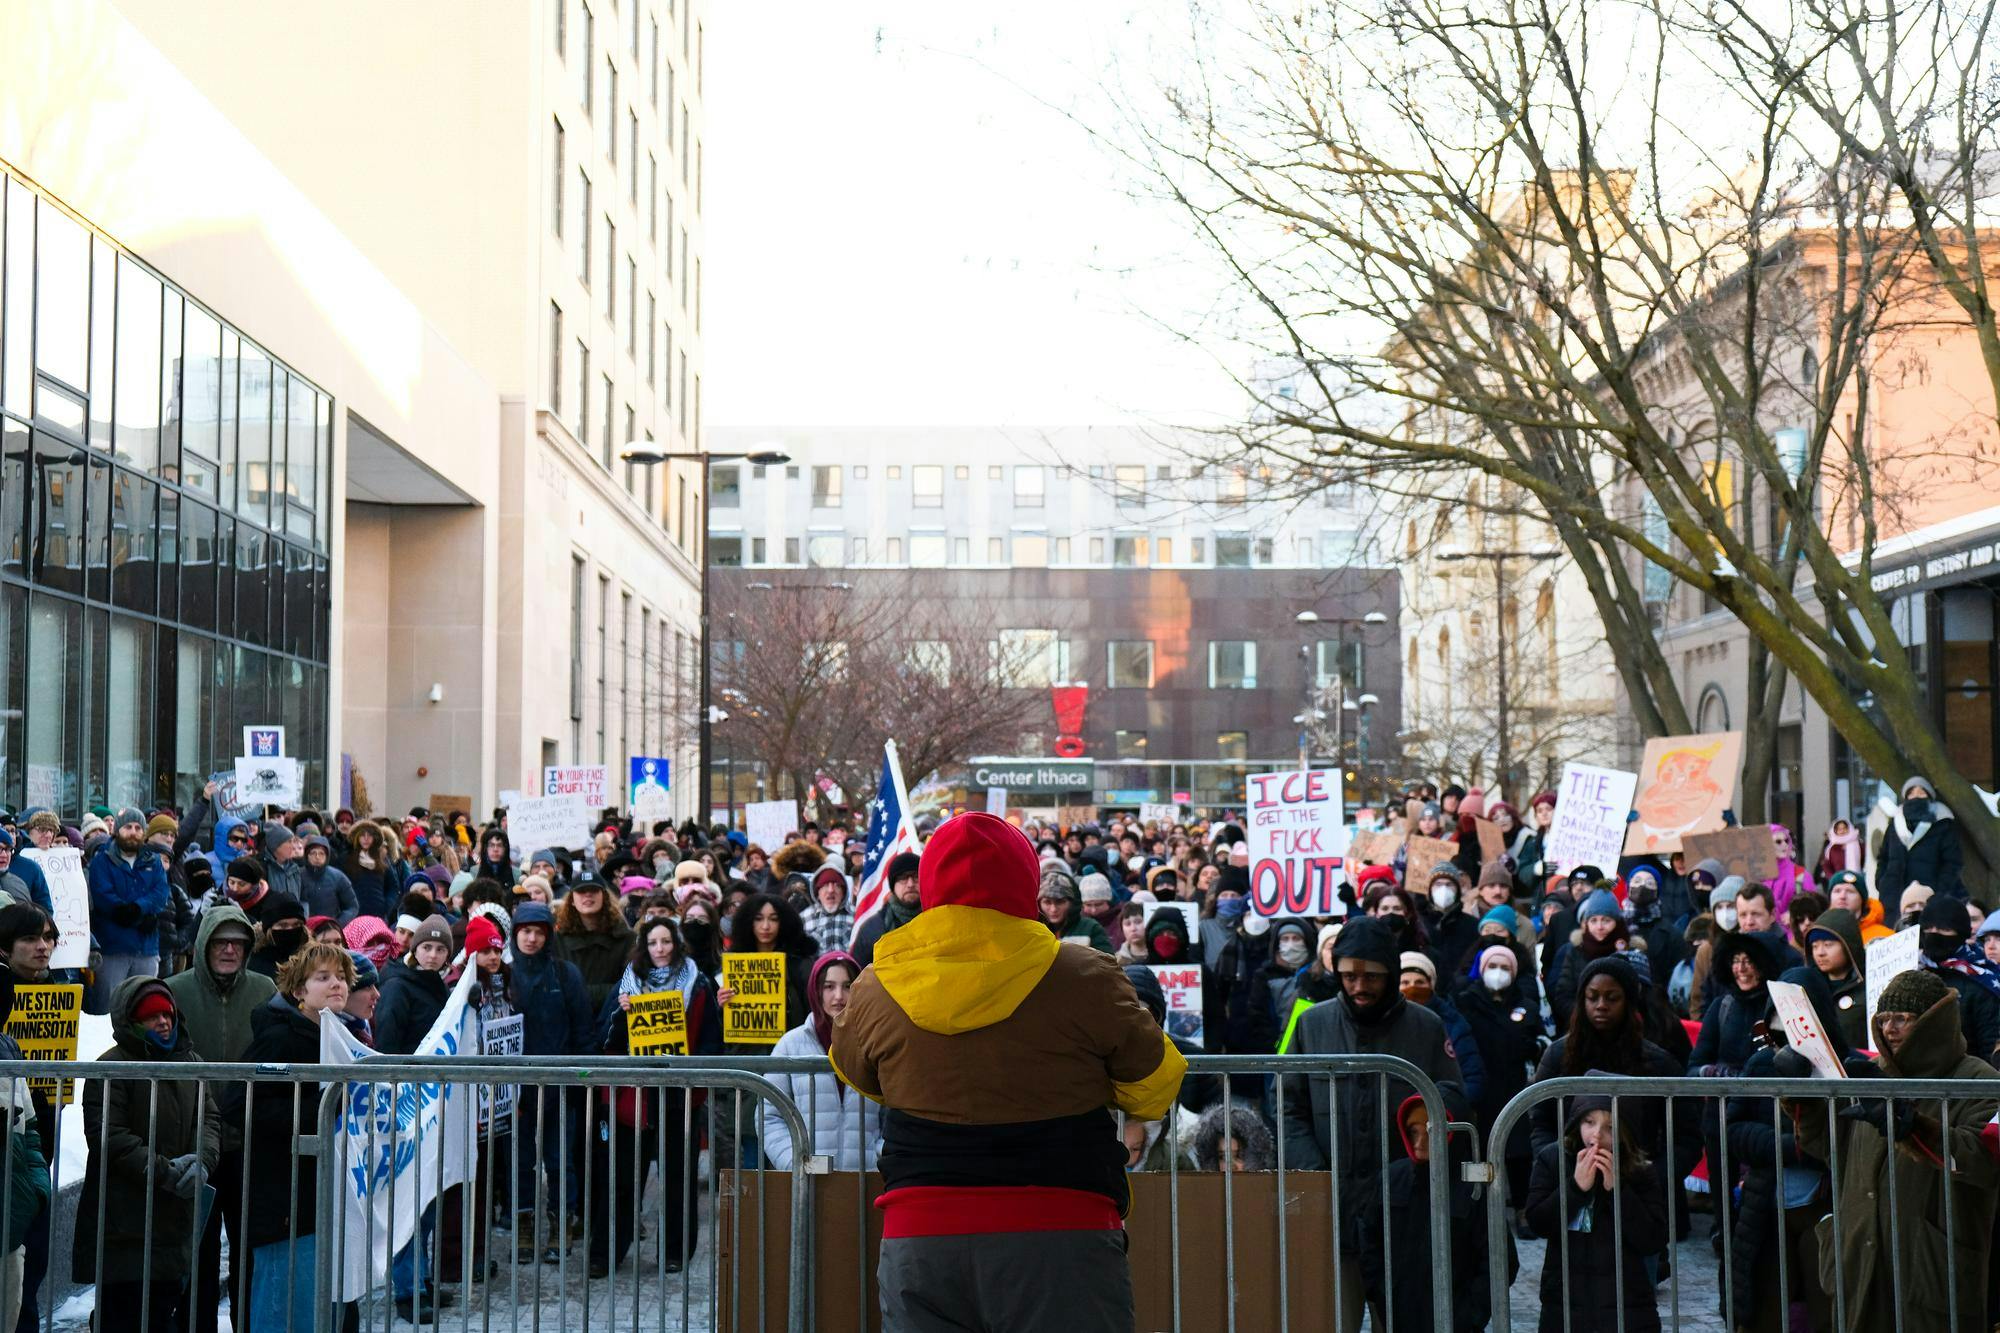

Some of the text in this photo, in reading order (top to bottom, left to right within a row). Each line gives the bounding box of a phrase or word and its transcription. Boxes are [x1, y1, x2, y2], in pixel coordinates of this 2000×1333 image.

[1906, 565, 1920, 585] FO
[1926, 550, 1969, 579] HISTORY
[1970, 545, 1993, 568] AND
[976, 768, 1087, 785] Center Ithaca
[1571, 771, 1610, 802] THE
[1251, 771, 1329, 809] ICE
[1255, 808, 1320, 826] GET THE
[1565, 799, 1614, 823] MOST
[1269, 827, 1324, 855] FUCK
[48, 855, 80, 873] OUT
[1251, 857, 1344, 918] OUT
[728, 958, 780, 972] THE WHOLE
[729, 979, 780, 995] IS GUILTY
[13, 991, 75, 1011] WE STAND
[26, 1012, 60, 1020] WITH
[631, 1010, 684, 1030] ARE
[732, 1010, 778, 1029] DOWN!
[7, 1021, 77, 1039] MINNESOTA!
[487, 1022, 521, 1042] BILLIONAIRES
[631, 1025, 685, 1037] WELCOME
[487, 1036, 520, 1056] ARE THE
